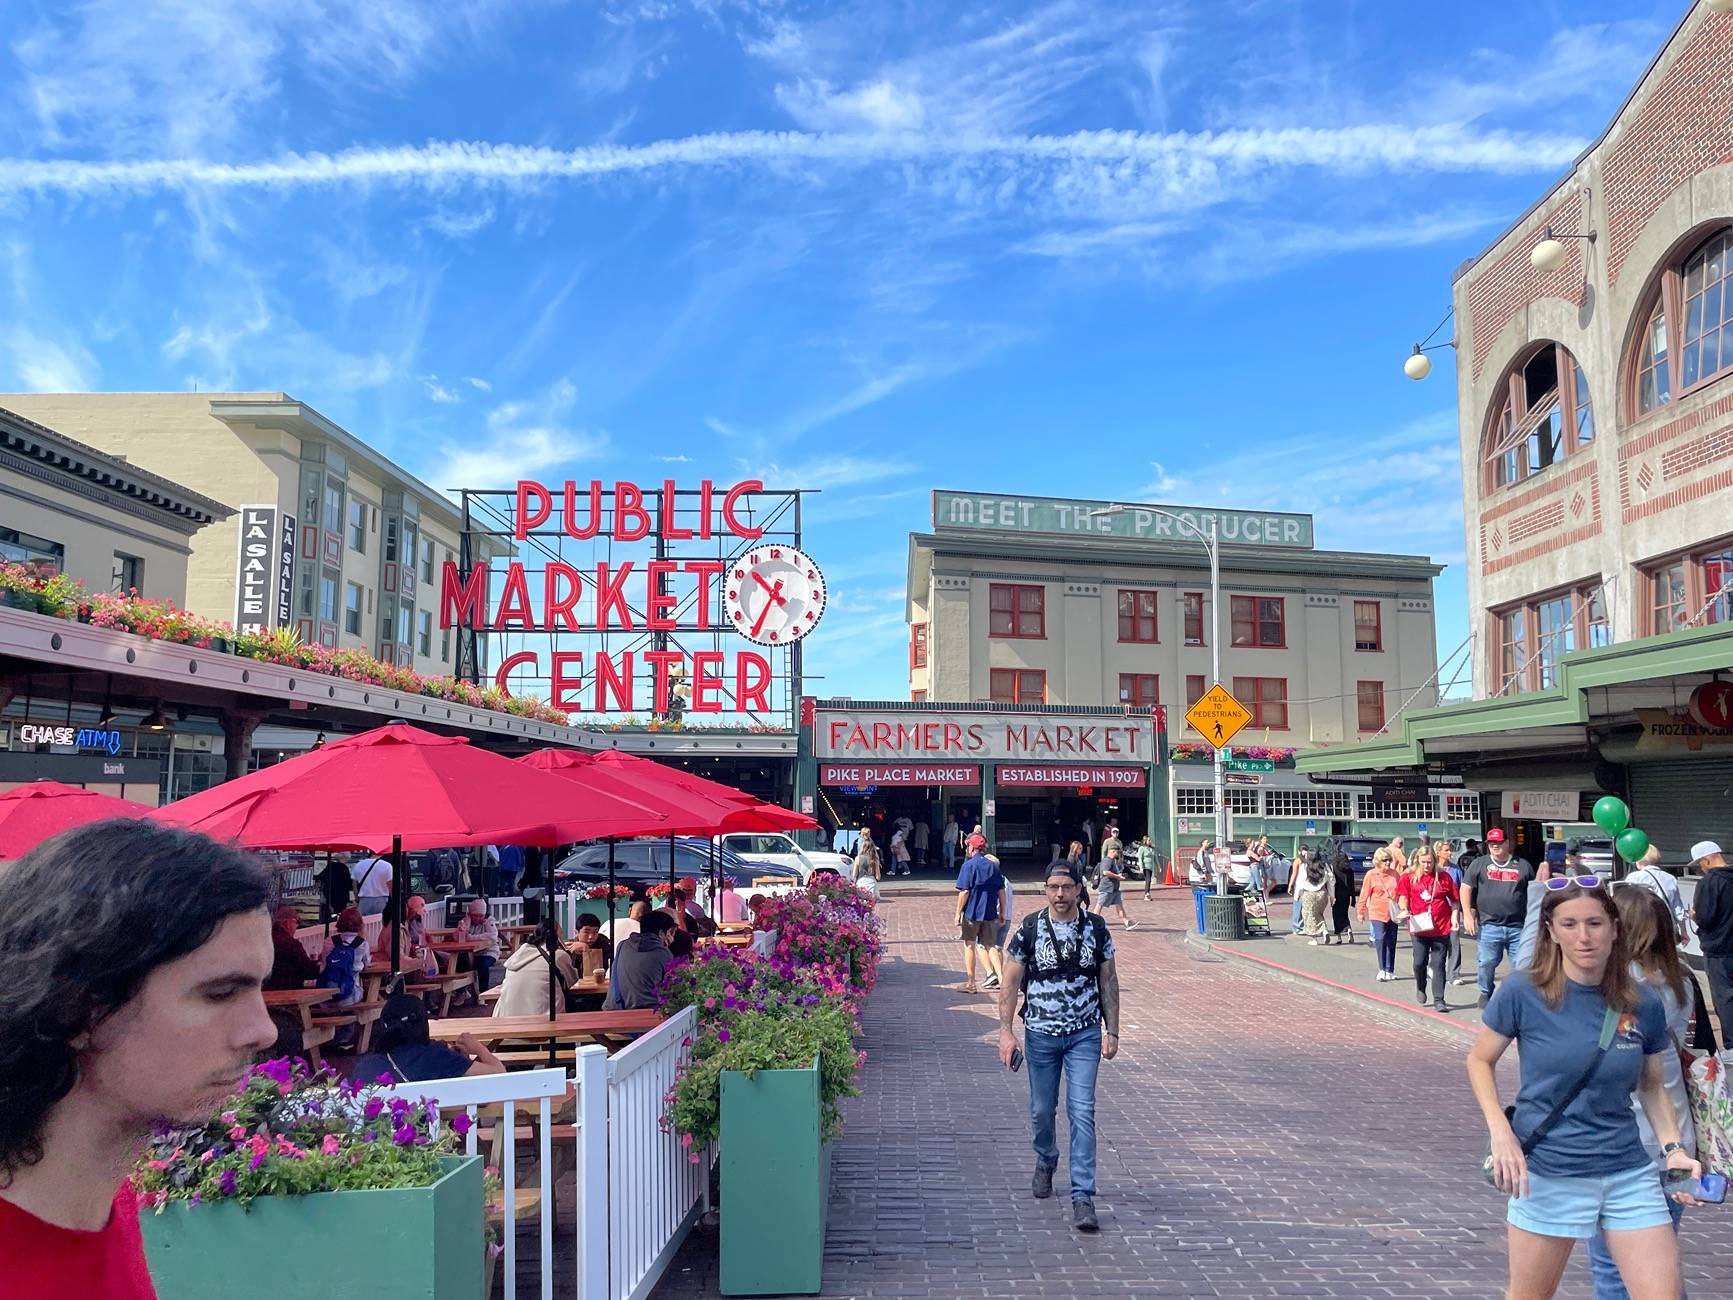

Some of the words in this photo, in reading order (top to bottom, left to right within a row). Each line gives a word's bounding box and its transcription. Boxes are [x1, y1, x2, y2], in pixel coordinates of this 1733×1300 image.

[515, 480, 763, 541] PUBLIC
[950, 497, 1035, 527] MEET
[1054, 504, 1112, 532] THE
[1135, 510, 1300, 542] PRODUCER
[750, 554, 758, 564] 11
[770, 549, 780, 559] 12
[735, 569, 744, 579] 10
[807, 569, 815, 579] 2
[440, 561, 725, 632] MARKET
[729, 590, 737, 600] 9
[812, 590, 820, 600] 3
[734, 610, 741, 620] 8
[805, 611, 814, 620] 4
[770, 631, 777, 640] 6
[792, 626, 799, 635] 5
[495, 651, 772, 714] CENTER
[1193, 710, 1242, 718] PEDESTRIANS
[1651, 723, 1697, 736] FROZEN
[21, 724, 74, 746] CHASE
[75, 729, 107, 748] ATM
[830, 722, 984, 750] FARMERS
[1006, 724, 1140, 753] MARKET
[103, 762, 125, 775] bank
[1228, 759, 1248, 770] Pike
[827, 768, 860, 781] PIKE
[865, 768, 911, 781] PLACE
[915, 768, 972, 781] MARKET
[1002, 769, 1090, 782] ESTABLISHED
[1092, 771, 1106, 782] IN
[1109, 771, 1139, 783] 1907
